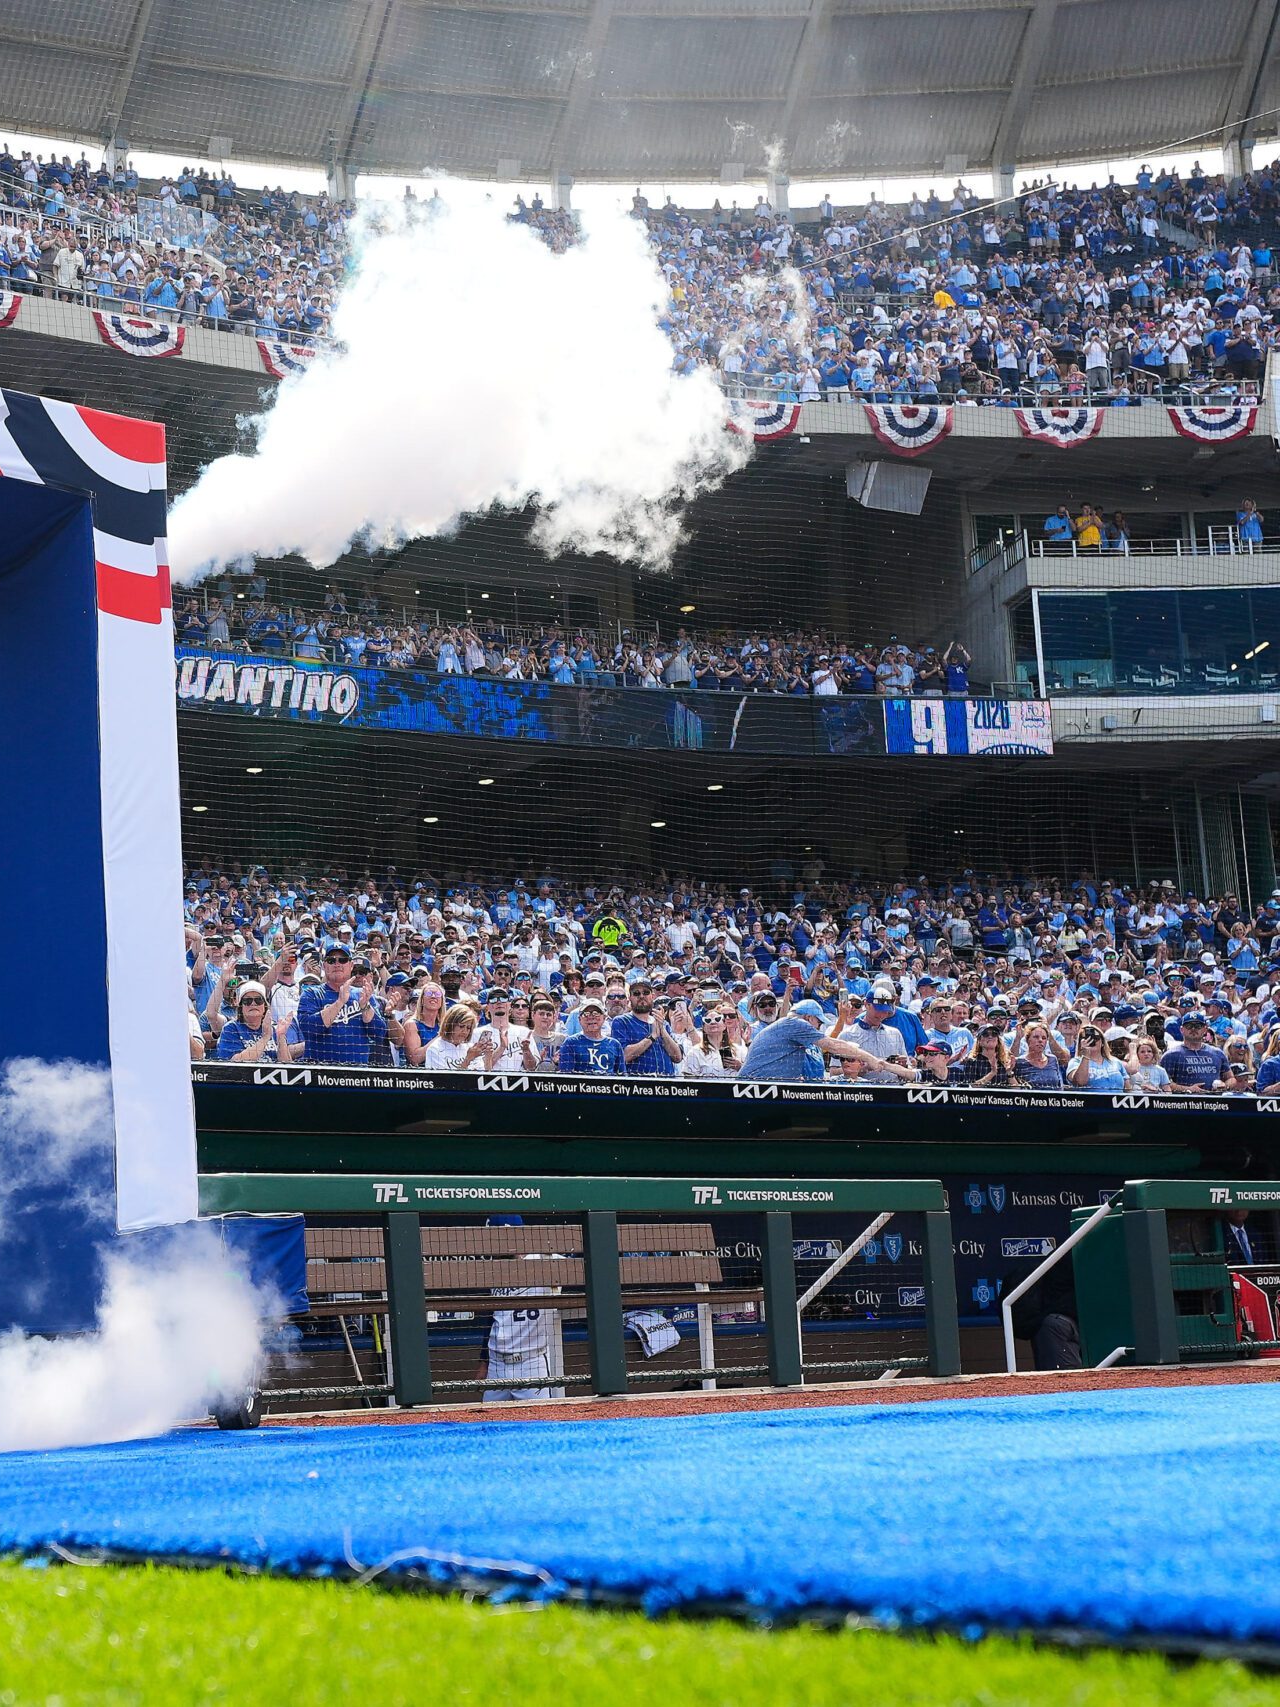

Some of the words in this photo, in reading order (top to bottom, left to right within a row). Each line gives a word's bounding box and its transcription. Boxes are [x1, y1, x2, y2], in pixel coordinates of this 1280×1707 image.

[175, 657, 359, 716] UANTINO
[972, 700, 1011, 730] 2026
[588, 1048, 609, 1070] KC
[1186, 1065, 1217, 1075] CHAMPS
[317, 1074, 370, 1088] Movement
[373, 1076, 394, 1088] that
[396, 1078, 434, 1091] inspires
[534, 1080, 555, 1093] Visit
[556, 1083, 577, 1095] your
[579, 1082, 611, 1095] Kansas
[612, 1084, 631, 1097] City
[632, 1085, 653, 1096] Area
[655, 1084, 670, 1096] Kia
[671, 1085, 699, 1097] Dealer
[782, 1088, 824, 1100] Movement
[825, 1089, 842, 1101] that
[843, 1090, 874, 1103] inspires
[951, 1093, 969, 1104] Visit
[970, 1095, 987, 1107] your
[988, 1095, 1014, 1106] Kansas
[1014, 1096, 1029, 1108] City
[1030, 1097, 1047, 1107] Area
[1048, 1097, 1061, 1107] Kia
[1061, 1097, 1084, 1108] Dealer
[1153, 1100, 1188, 1110] Movement
[1188, 1101, 1203, 1110] that
[1203, 1101, 1229, 1112] inspires
[372, 1183, 409, 1203] TFL
[415, 1187, 541, 1200] TICKETSFORLESS.COM
[691, 1185, 722, 1205] TFL
[727, 1189, 834, 1202] TICKETSFORLESS.COM
[1011, 1191, 1057, 1206] Kansas
[1059, 1191, 1085, 1208] City
[1209, 1187, 1233, 1204] TFL
[735, 1241, 763, 1262] City
[959, 1239, 986, 1259] City
[855, 1289, 882, 1308] City
[672, 1310, 696, 1323] GIANTS
